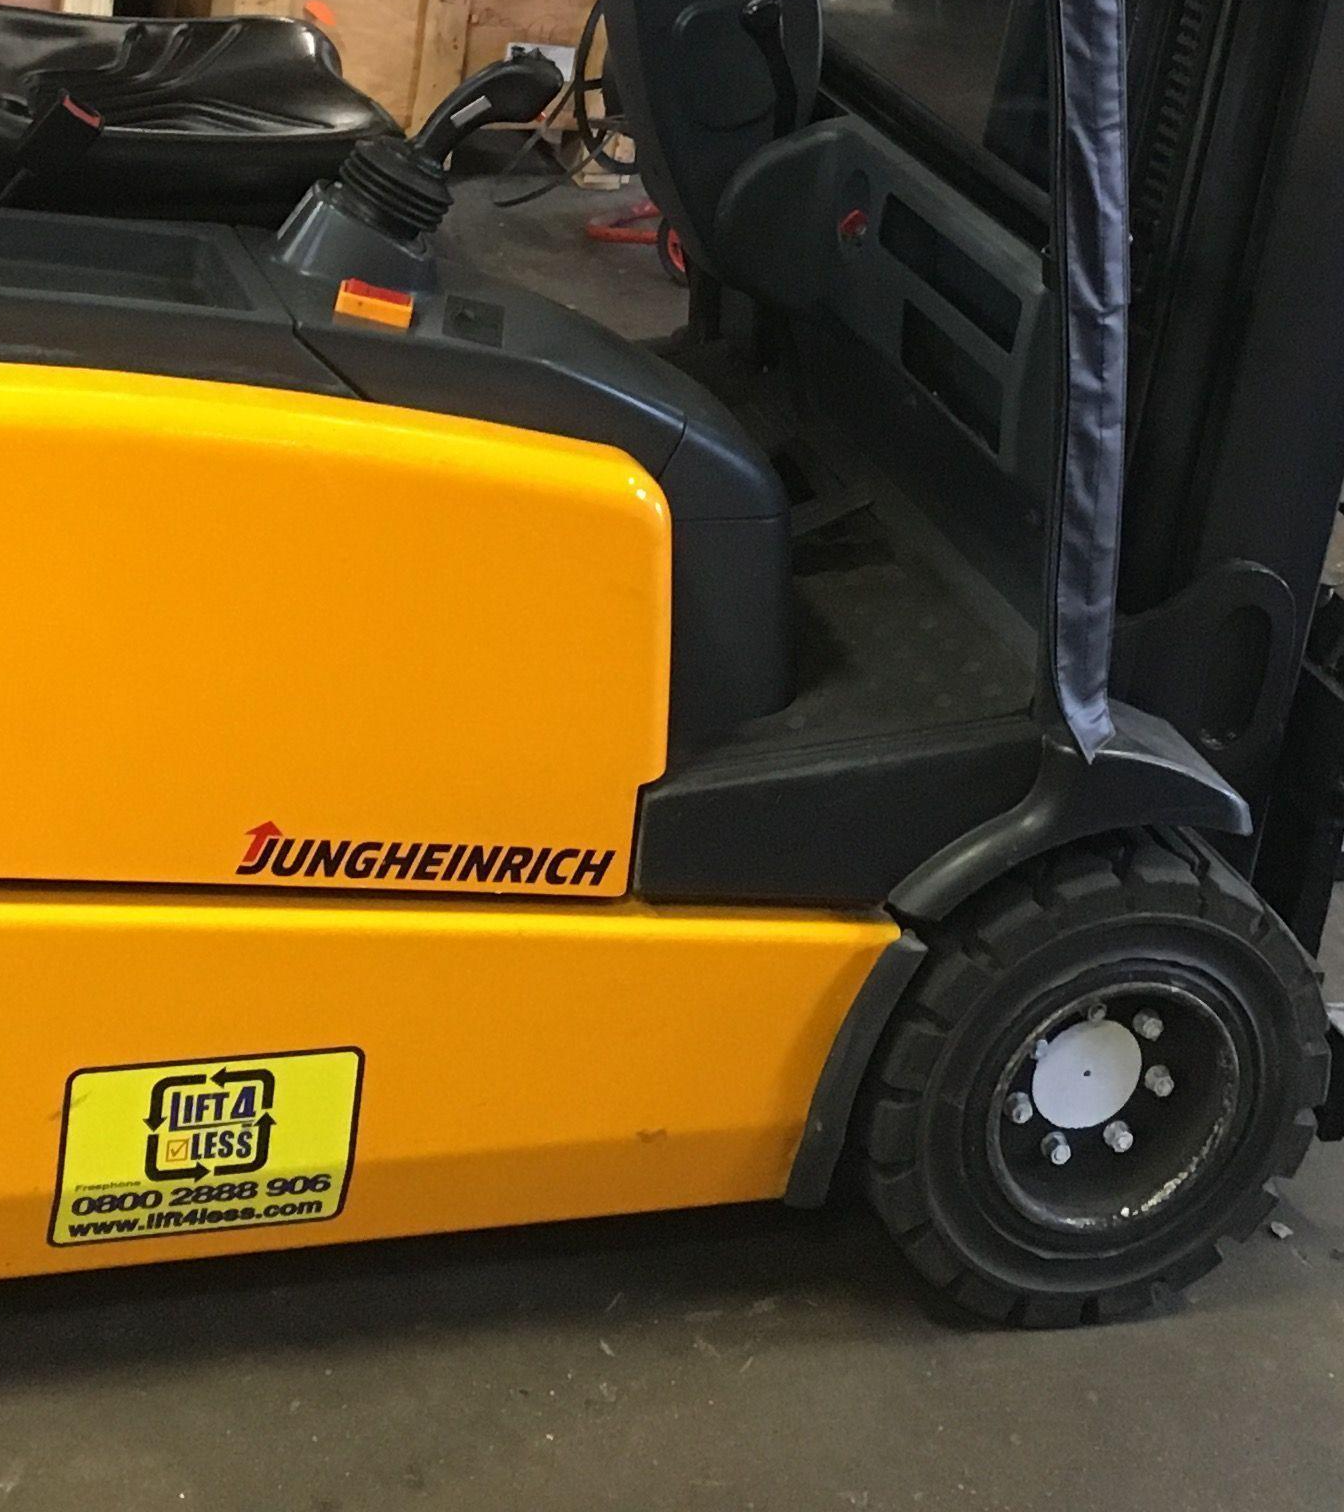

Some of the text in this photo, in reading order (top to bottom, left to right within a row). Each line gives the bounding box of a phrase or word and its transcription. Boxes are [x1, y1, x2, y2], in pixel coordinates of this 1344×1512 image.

[234, 838, 617, 887] JUNGHEINRICH
[190, 1129, 254, 1161] LESS
[70, 1173, 332, 1217] 0800 2888 906
[67, 1199, 324, 1238] www.lift4less.com
